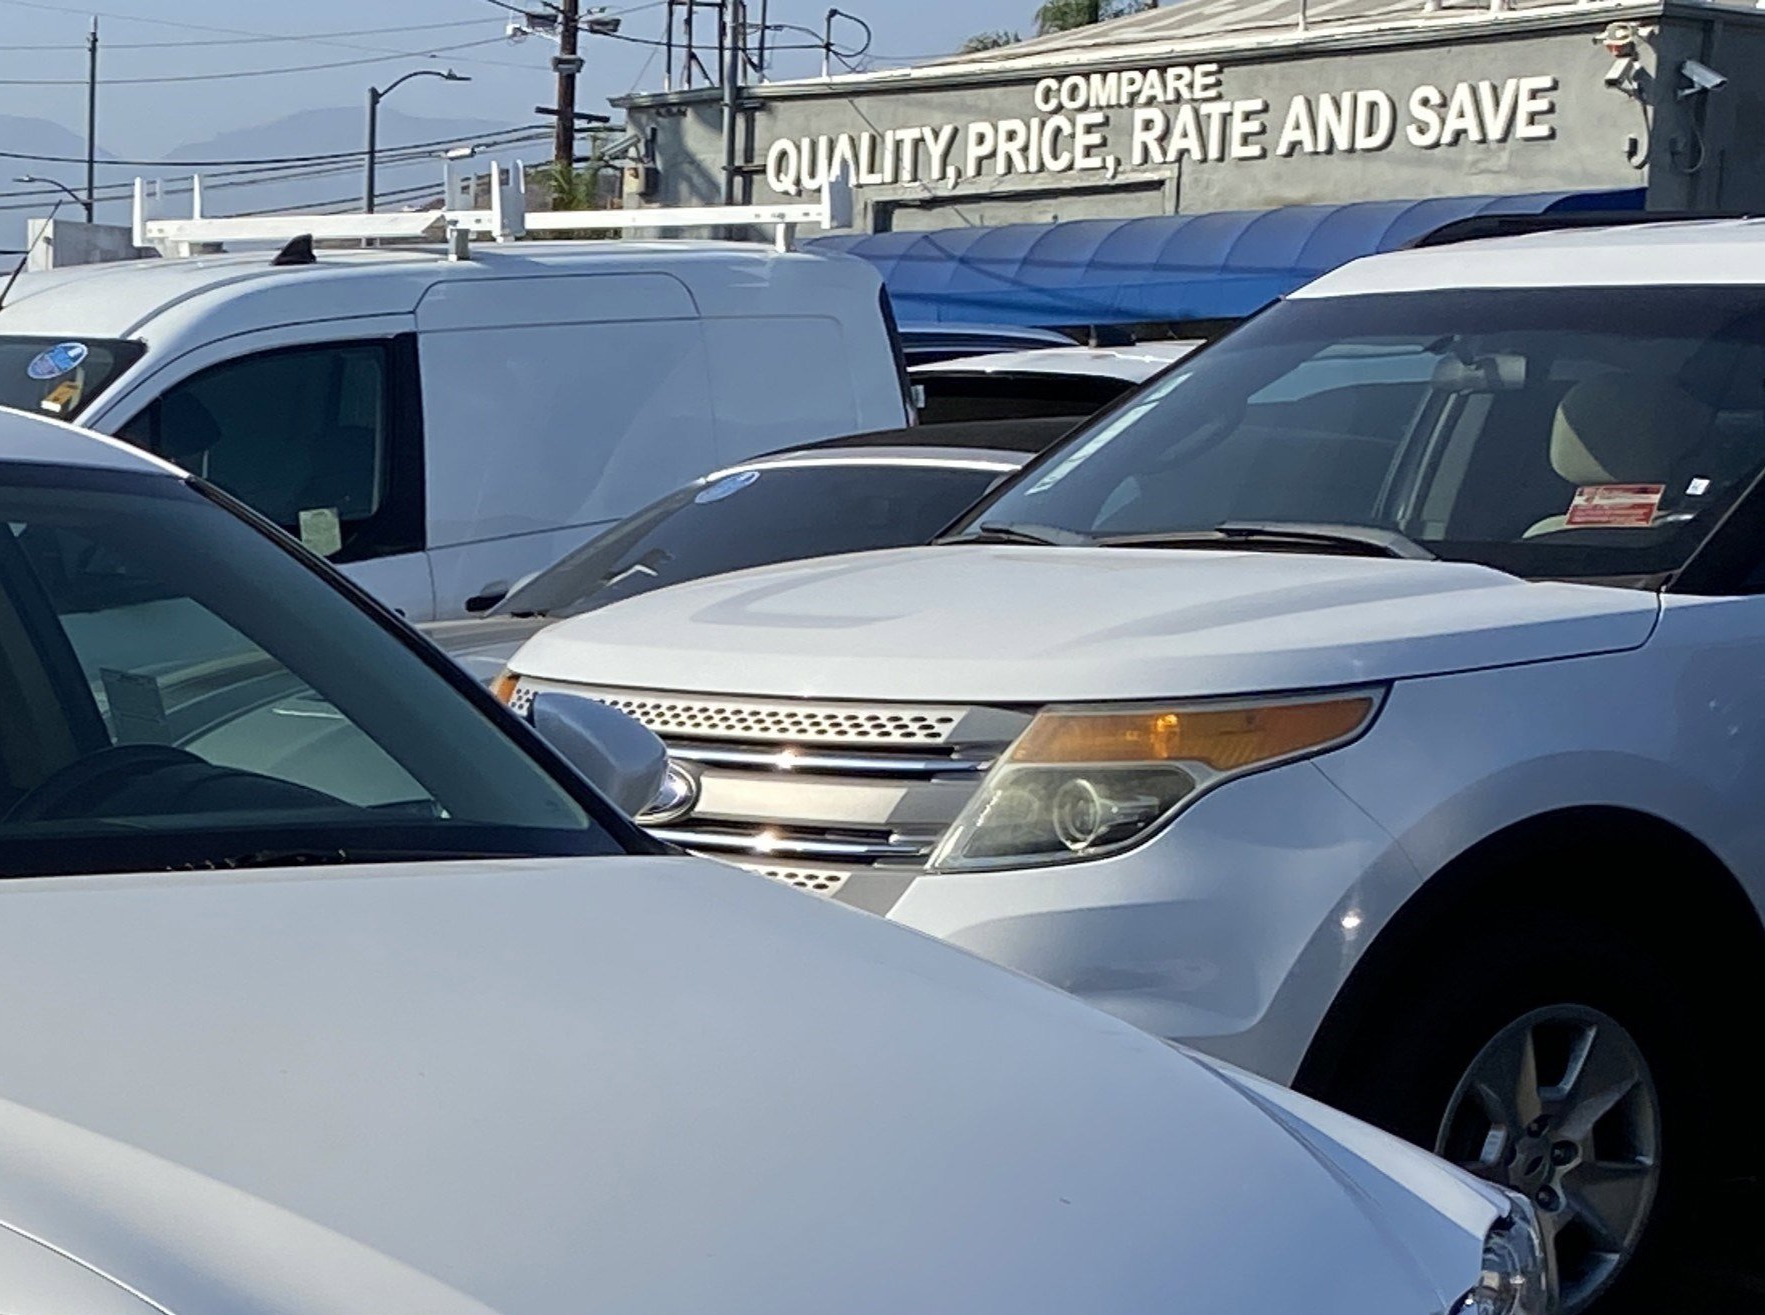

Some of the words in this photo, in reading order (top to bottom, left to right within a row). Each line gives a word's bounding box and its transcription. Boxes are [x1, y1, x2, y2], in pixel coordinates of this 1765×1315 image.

[1034, 63, 1219, 112] COMPARE
[766, 124, 960, 196] QUALITY,
[966, 111, 1118, 179] PRICE,
[1131, 98, 1264, 165] RATE
[1276, 89, 1392, 156] AND
[1405, 75, 1554, 147] SAVE
